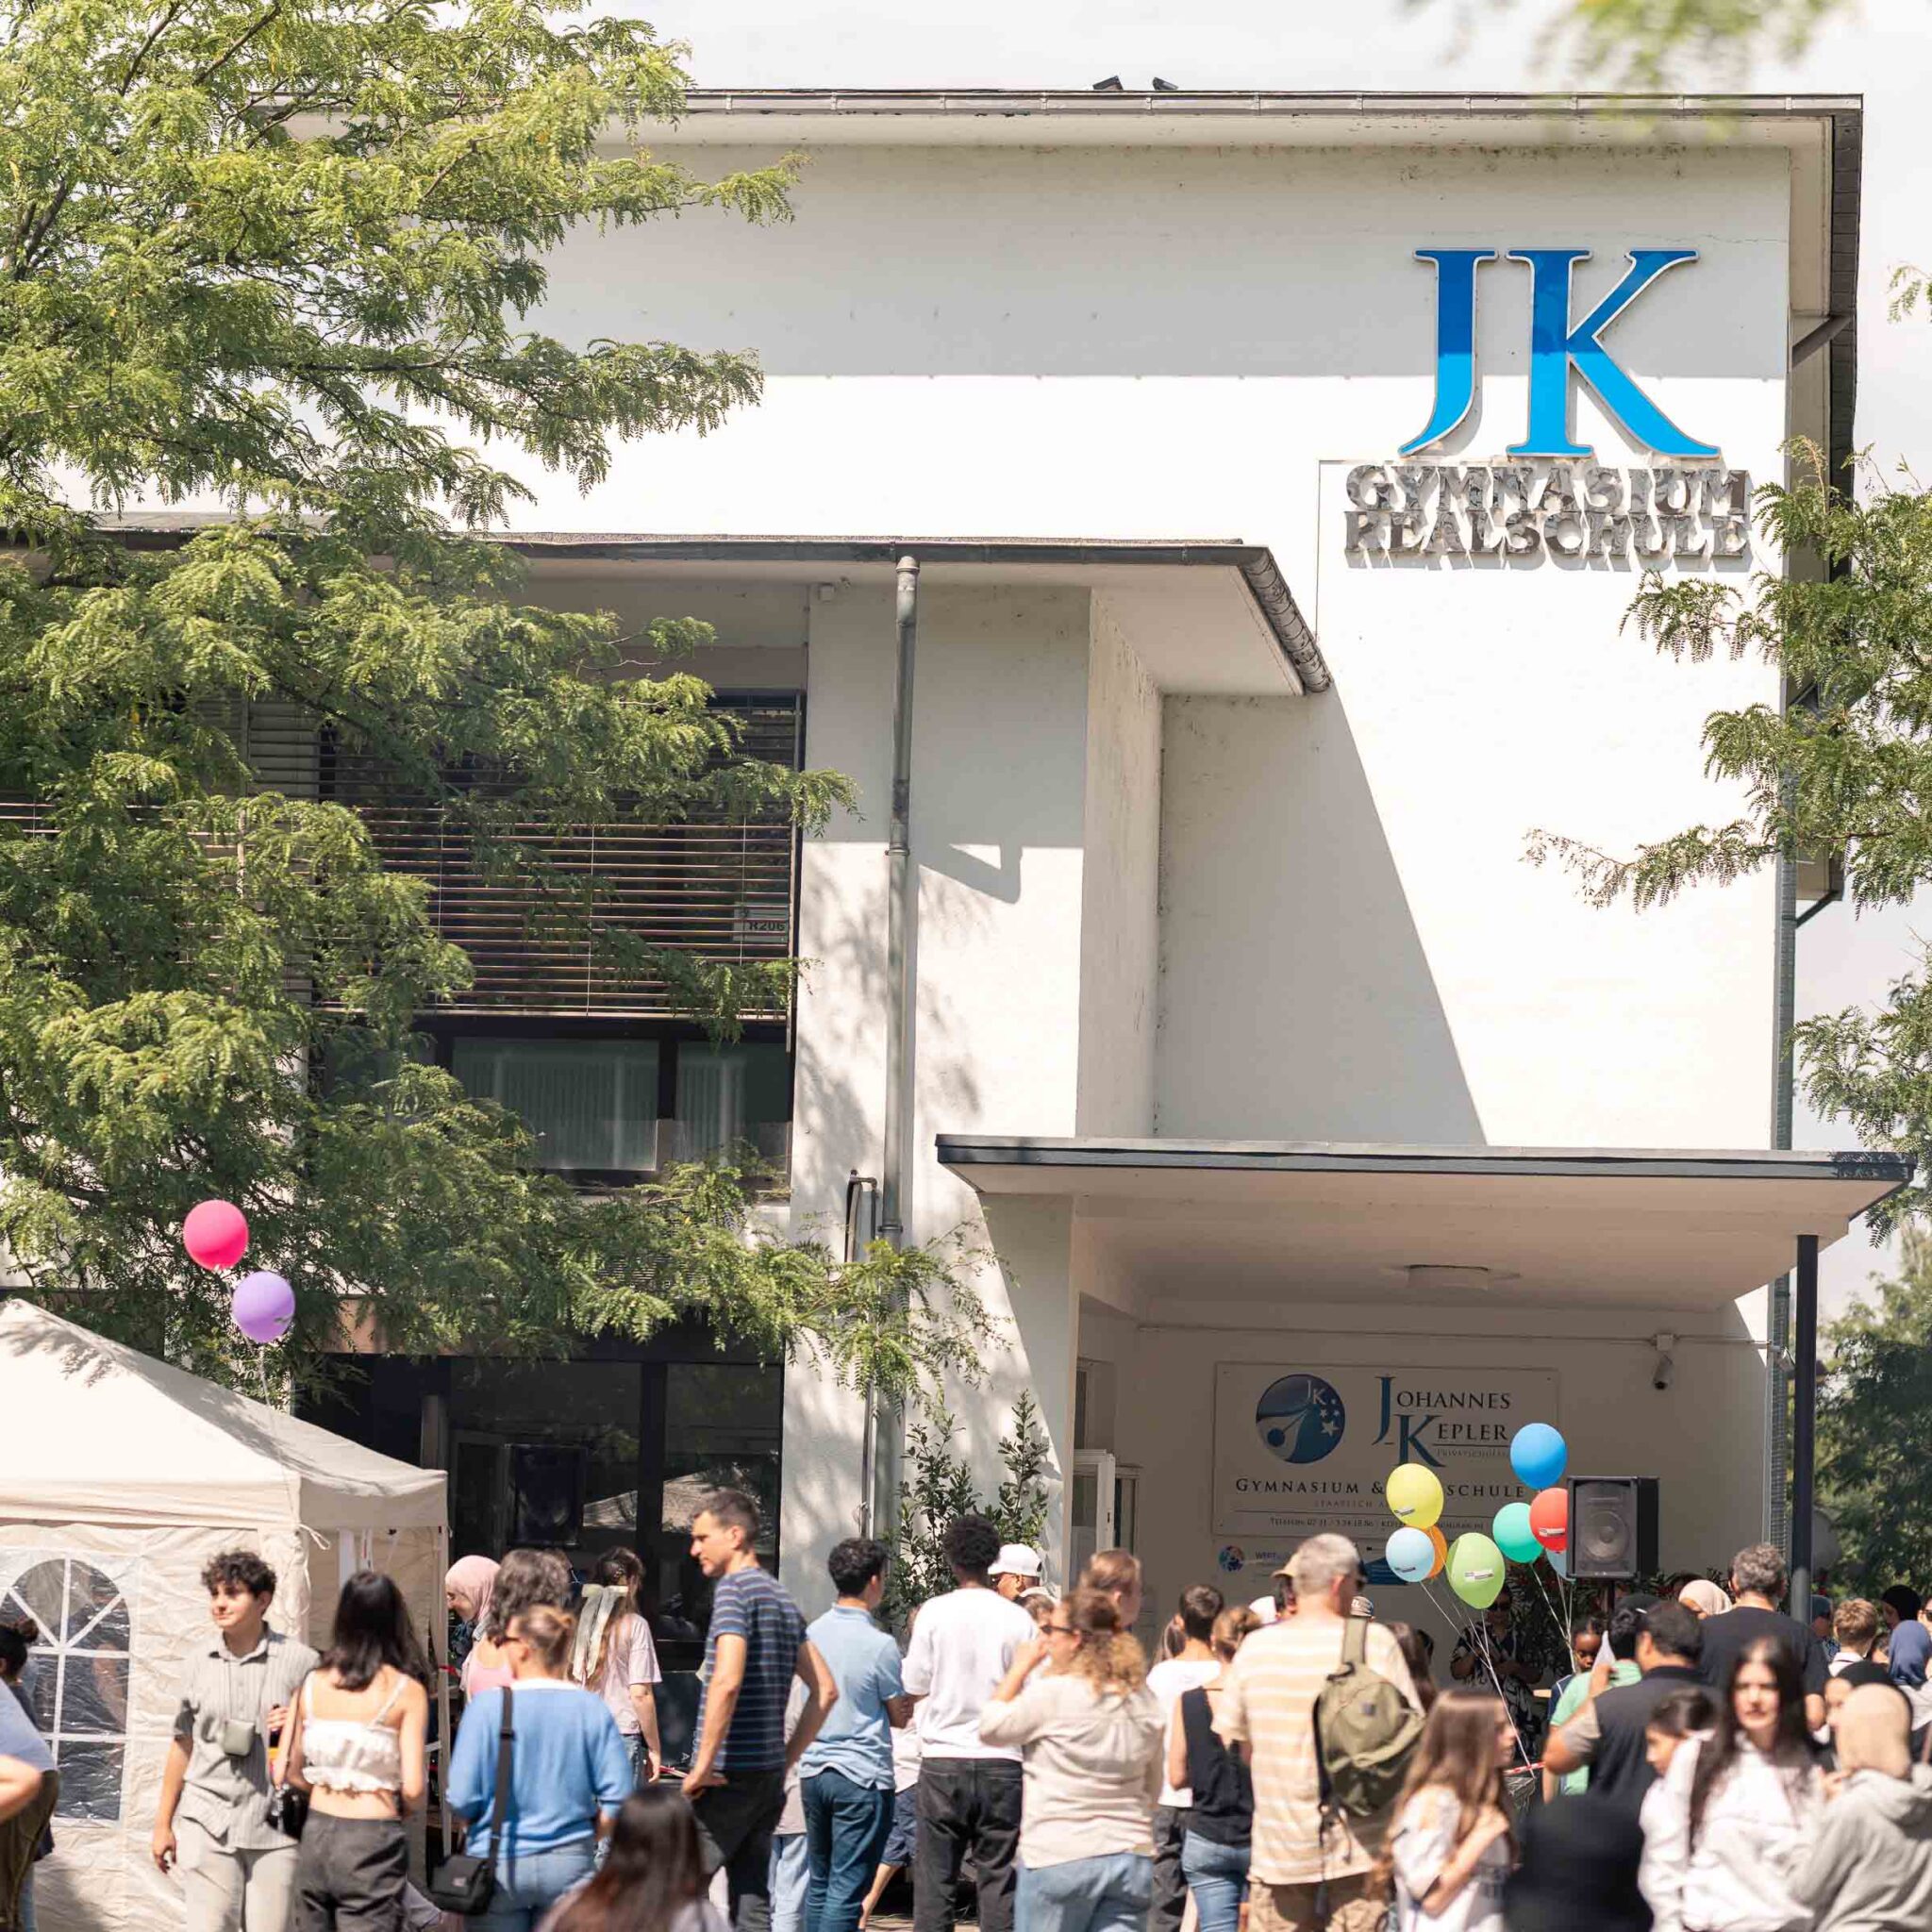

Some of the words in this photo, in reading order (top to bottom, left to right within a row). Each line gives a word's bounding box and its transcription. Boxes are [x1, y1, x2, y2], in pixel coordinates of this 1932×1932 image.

[1397, 247, 1721, 458] JK
[1345, 465, 1750, 515] GYMNASIUM
[1344, 510, 1752, 558] REALSCHULE
[1235, 1477, 1359, 1494] GYMNASIUM
[1371, 1480, 1385, 1495] &
[1446, 1484, 1525, 1498] SCHULE
